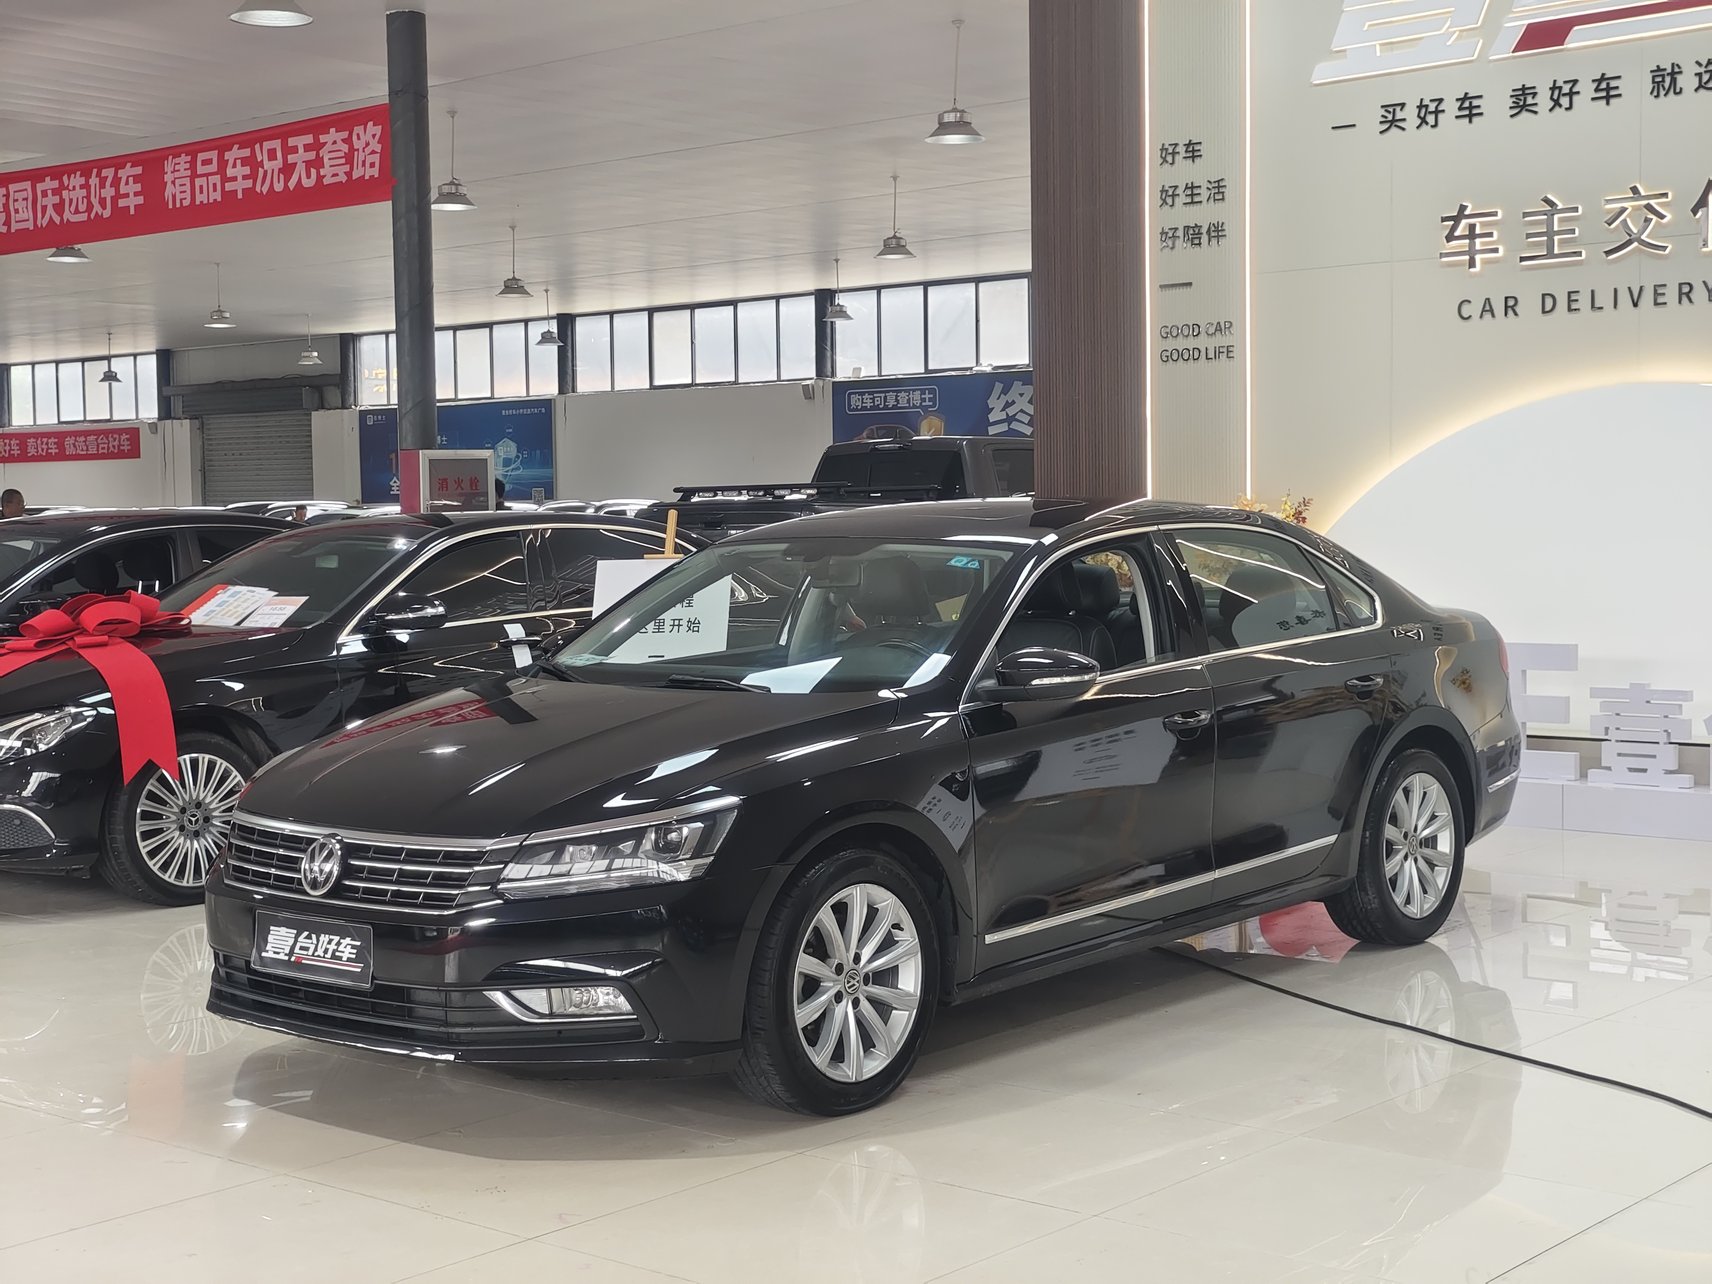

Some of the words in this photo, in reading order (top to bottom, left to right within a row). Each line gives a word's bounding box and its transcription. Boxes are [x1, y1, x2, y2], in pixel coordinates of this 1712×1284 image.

[1379, 92, 1485, 135] 买好车
[1509, 73, 1623, 119] 卖好车
[164, 121, 383, 209] 精品车况无套路
[1159, 139, 1203, 167] 好车
[1159, 177, 1227, 208] 好生活
[1159, 220, 1227, 250] 好陪伴
[1457, 295, 1520, 321] CAR
[1160, 322, 1201, 339] GOOD
[1205, 320, 1233, 337] CAR
[1160, 347, 1201, 363] GOOD
[1205, 345, 1235, 361] LIFE
[850, 391, 933, 409] 购车可享查博士
[27, 437, 59, 456] 卖好车
[64, 433, 131, 455] 就选壹台好车
[437, 476, 481, 492] 消火栓
[262, 926, 361, 961] 壹台好车
